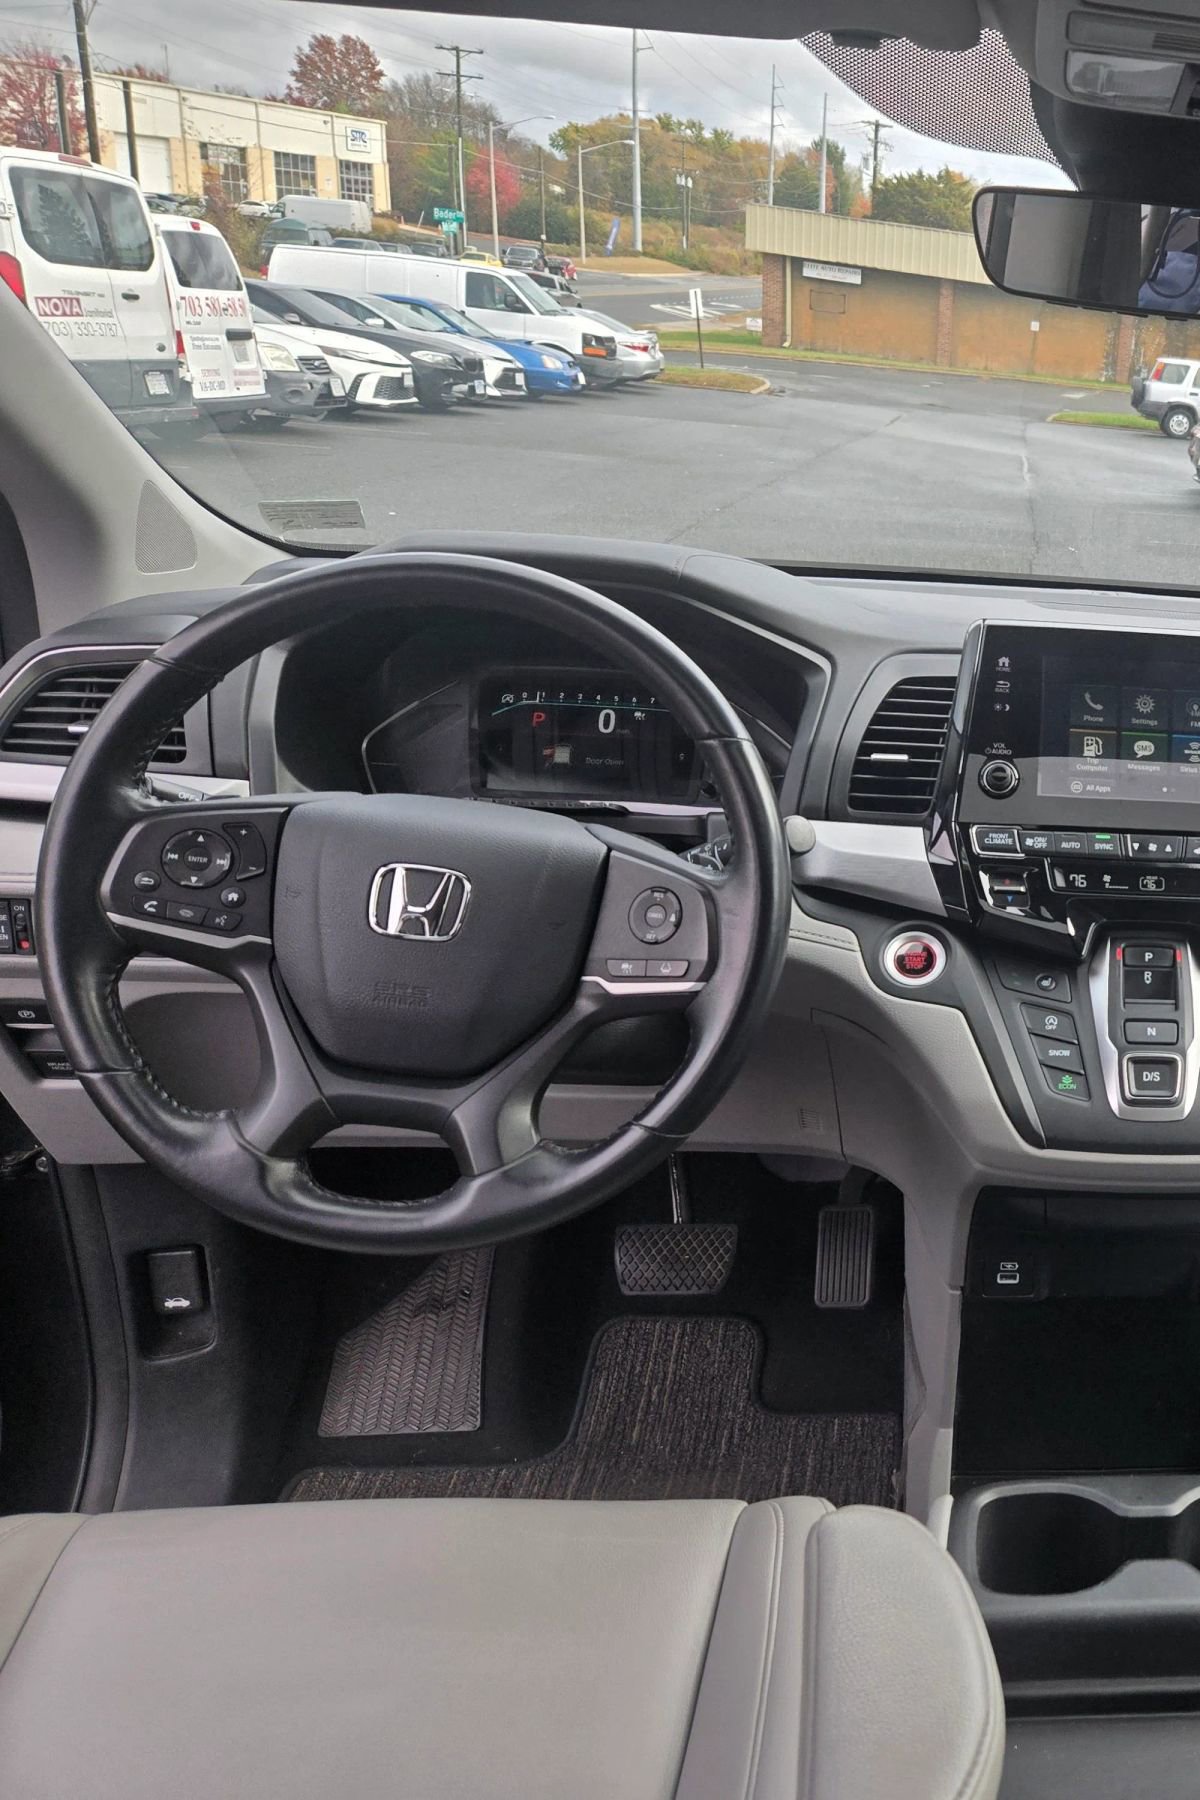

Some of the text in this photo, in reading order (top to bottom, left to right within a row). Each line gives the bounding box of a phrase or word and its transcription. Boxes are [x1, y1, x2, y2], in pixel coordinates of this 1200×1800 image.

[434, 207, 456, 219] Bader
[820, 265, 837, 273] AUTO
[36, 298, 82, 316] NOVA
[180, 296, 204, 317] 703
[532, 712, 546, 727] P
[599, 709, 616, 734] 0
[1131, 718, 1158, 726] Settings
[585, 757, 603, 765] Door
[1076, 763, 1108, 772] Computer
[1127, 764, 1161, 772] Messages
[1095, 785, 1111, 793] Apps
[178, 791, 200, 800] OFF
[188, 856, 208, 864] ENTER
[1069, 874, 1087, 888] 76
[1143, 880, 1156, 890] 76
[1144, 952, 1153, 962] P
[1147, 1027, 1156, 1036] N
[1142, 1071, 1161, 1082] D/S
